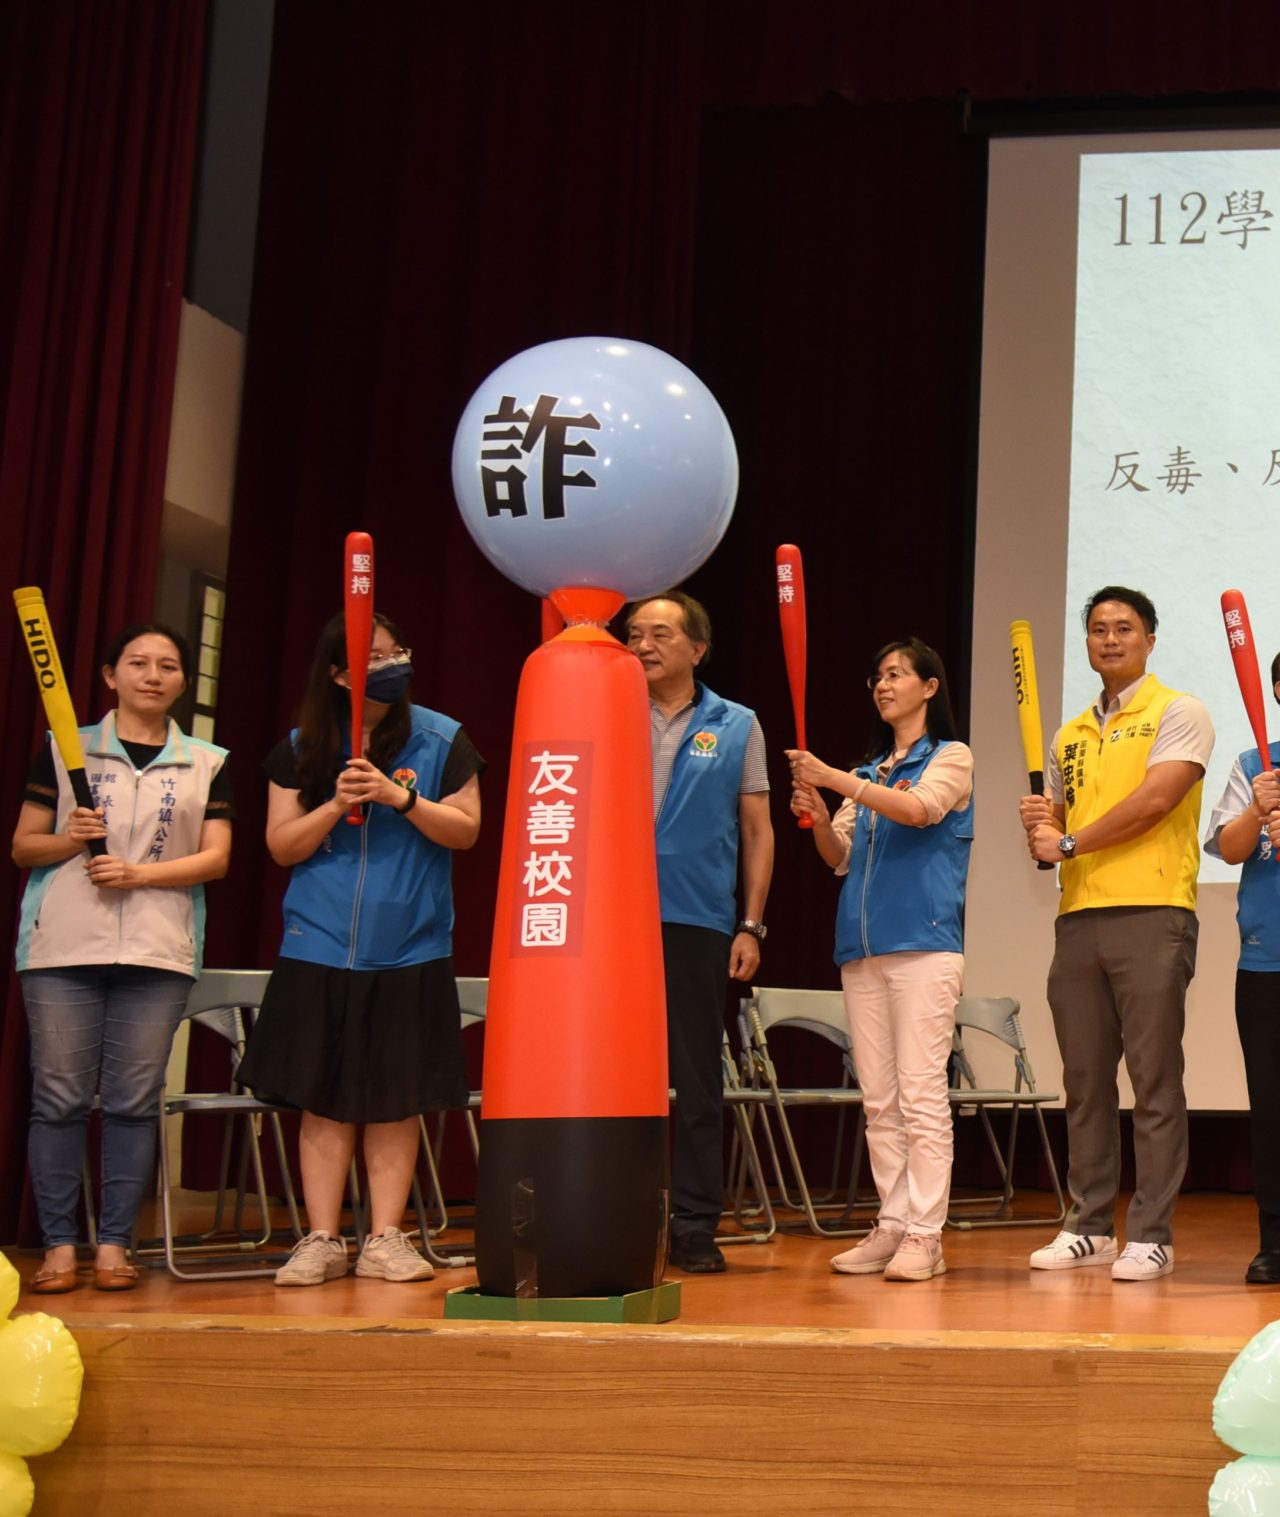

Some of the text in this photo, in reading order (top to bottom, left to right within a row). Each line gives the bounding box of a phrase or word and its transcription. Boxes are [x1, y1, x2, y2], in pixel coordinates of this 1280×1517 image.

[481, 394, 601, 520] 詐
[351, 553, 371, 594] 堅持
[777, 564, 794, 604] 堅持
[24, 618, 56, 689] HIDO
[1225, 609, 1246, 649] 堅持
[148, 778, 176, 862] 竹南鎮公所
[521, 751, 580, 948] 友善校園
